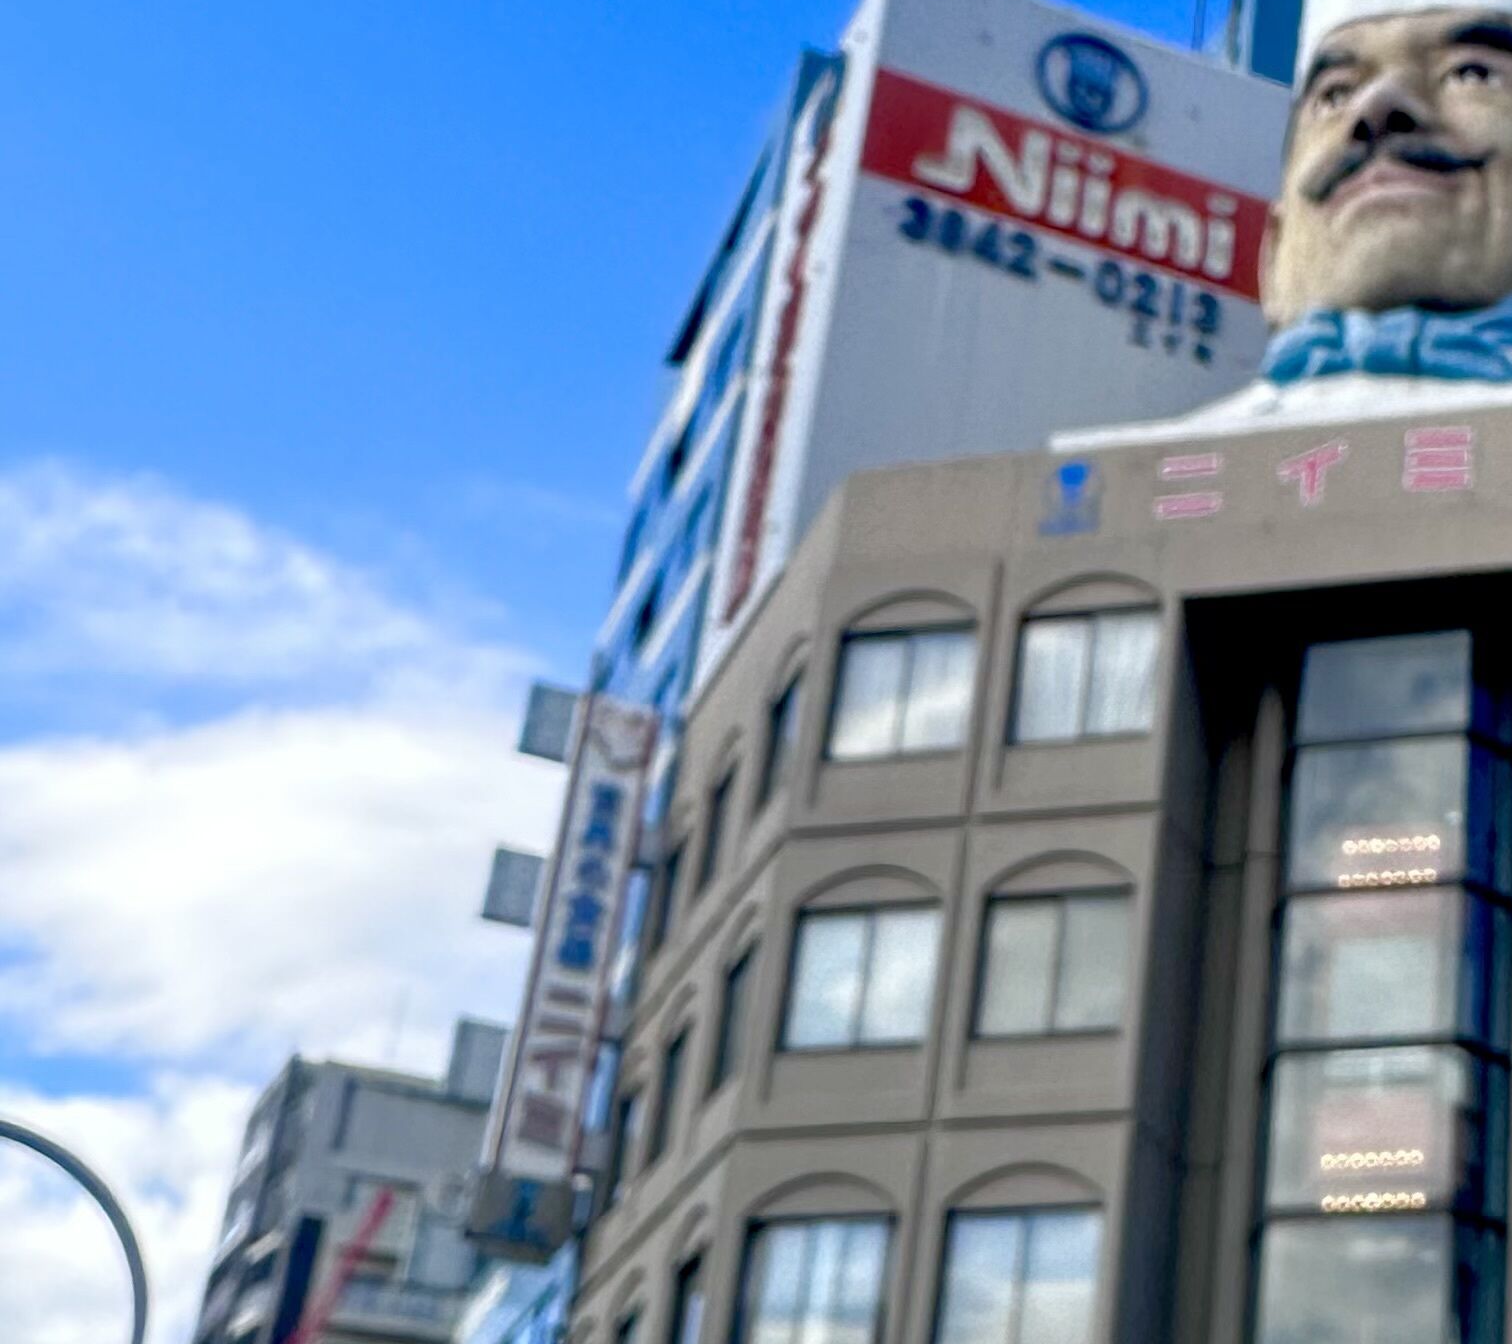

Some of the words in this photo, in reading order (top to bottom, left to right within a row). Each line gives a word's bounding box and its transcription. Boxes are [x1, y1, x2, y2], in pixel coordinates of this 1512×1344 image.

[912, 106, 1238, 280] Niimi
[1154, 426, 1473, 520] ニイミ
